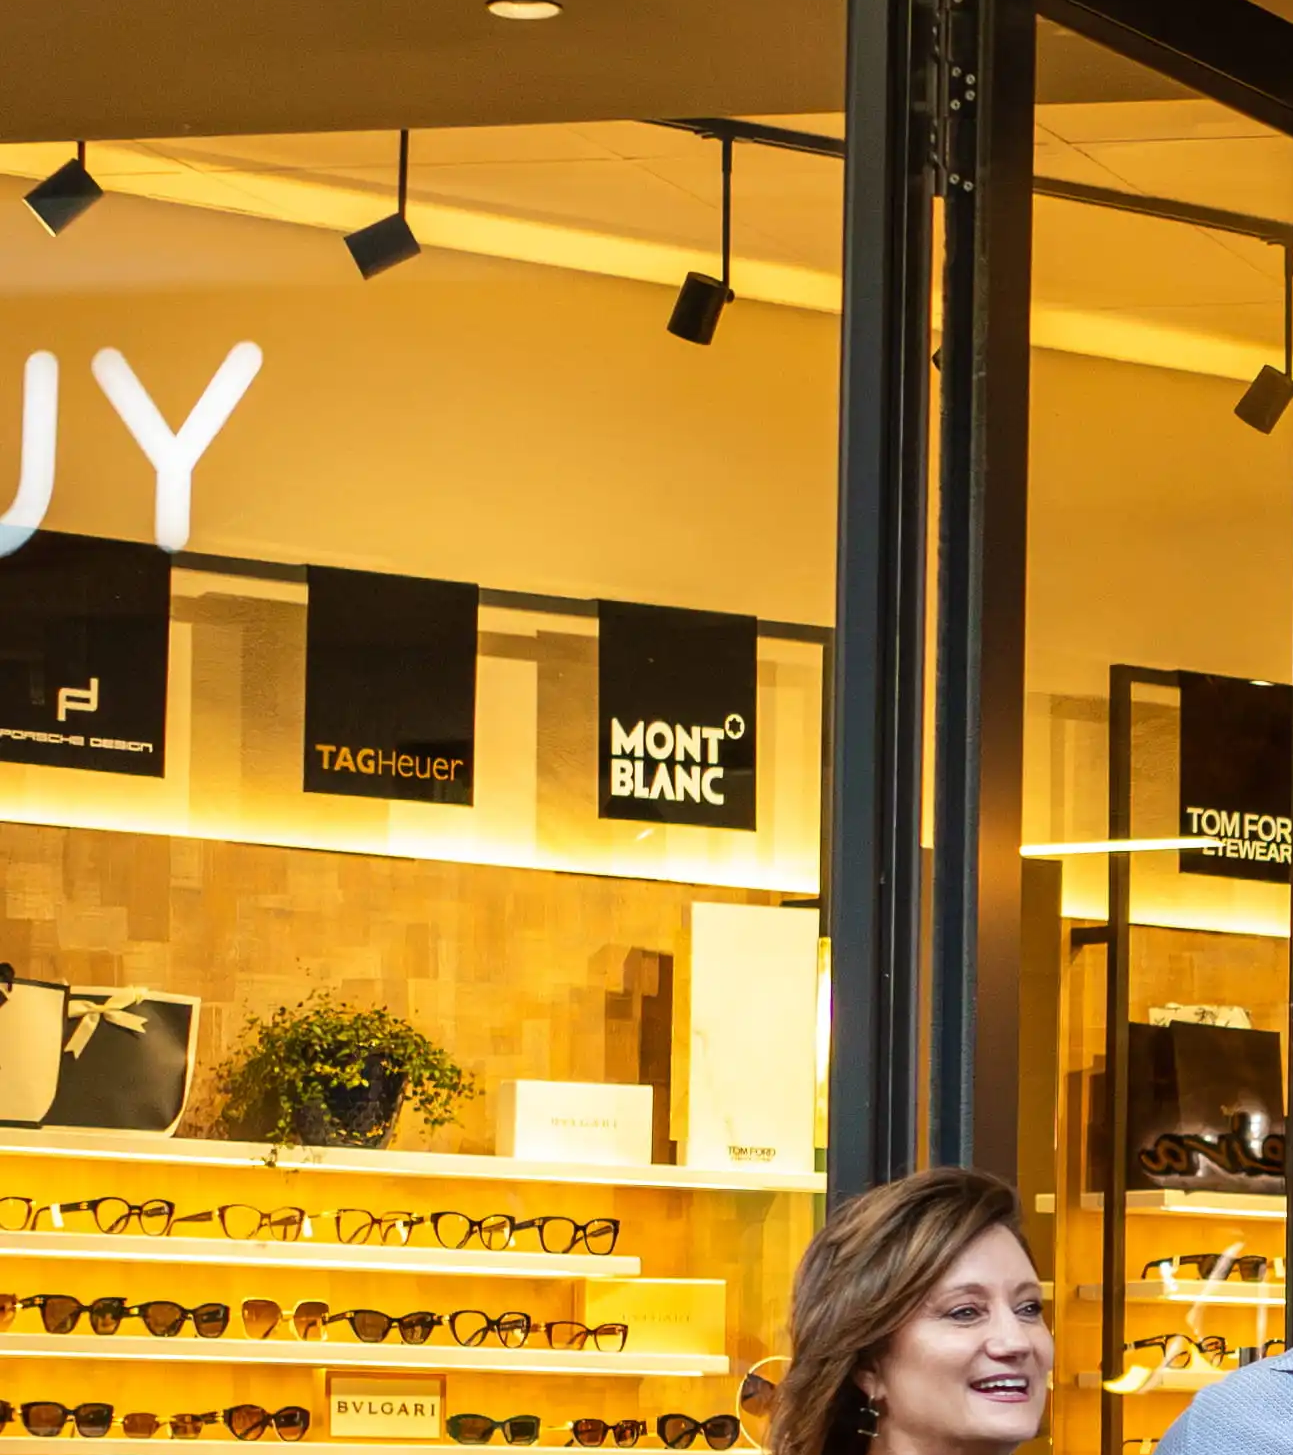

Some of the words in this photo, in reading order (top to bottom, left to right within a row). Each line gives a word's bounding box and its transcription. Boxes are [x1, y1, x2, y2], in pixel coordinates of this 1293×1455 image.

[611, 717, 725, 765] MONT
[611, 758, 724, 805] BLANC
[1186, 807, 1240, 838] TOM
[1244, 813, 1292, 844] FOR
[337, 1400, 435, 1416] BVLGARI
